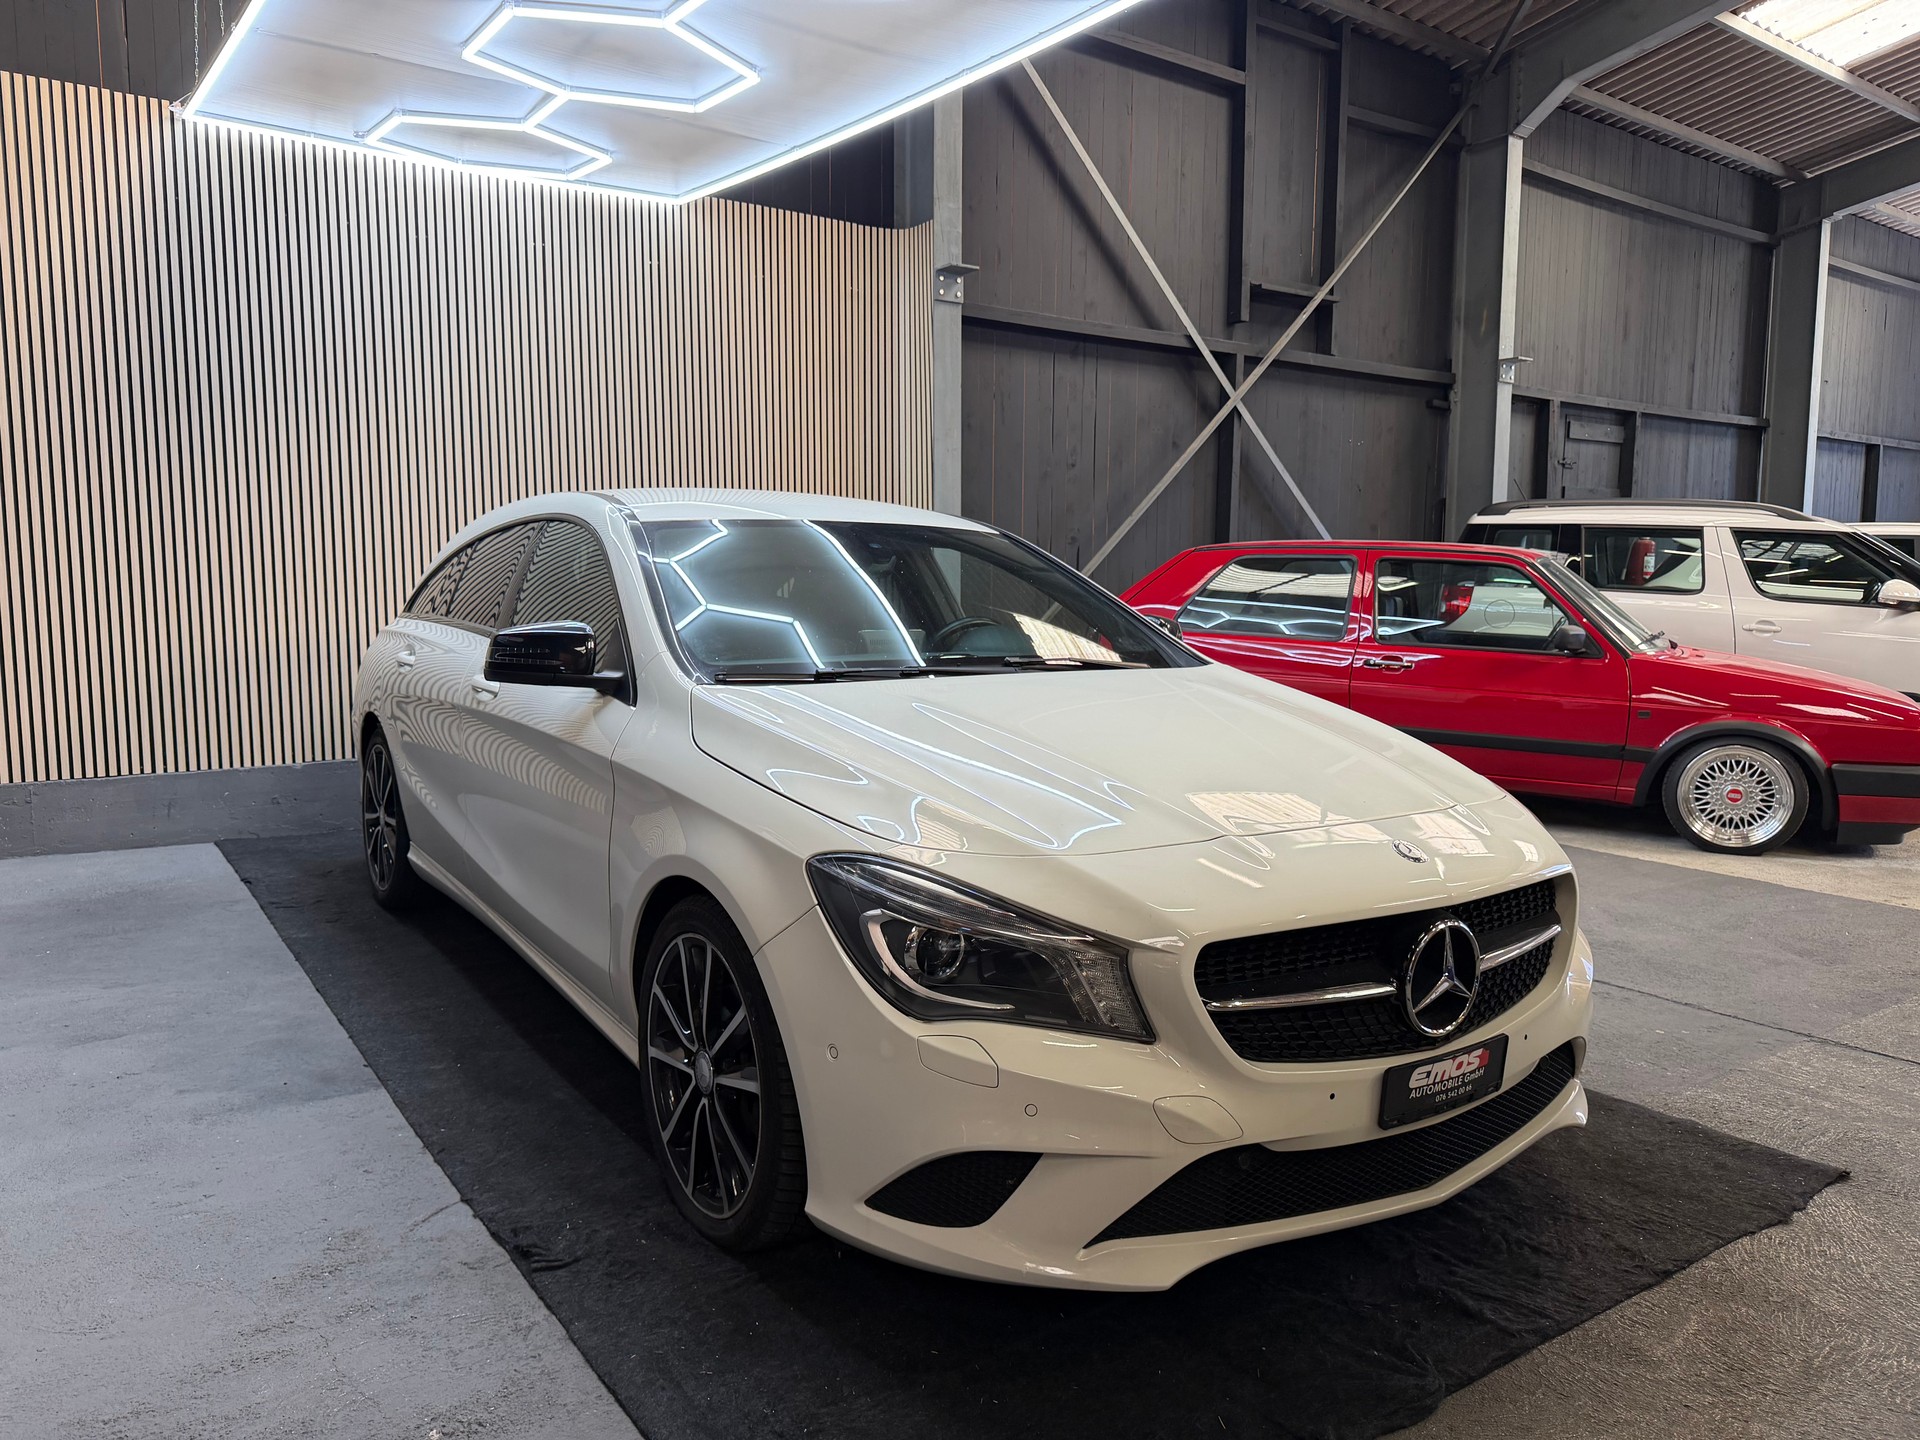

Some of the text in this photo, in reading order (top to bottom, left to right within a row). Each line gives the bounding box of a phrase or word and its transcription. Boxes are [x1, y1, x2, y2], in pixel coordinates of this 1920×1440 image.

[1409, 1067, 1485, 1099] AUTOMOBILE GmbH
[1435, 1094, 1446, 1102] 076
[1448, 1090, 1458, 1098] 542
